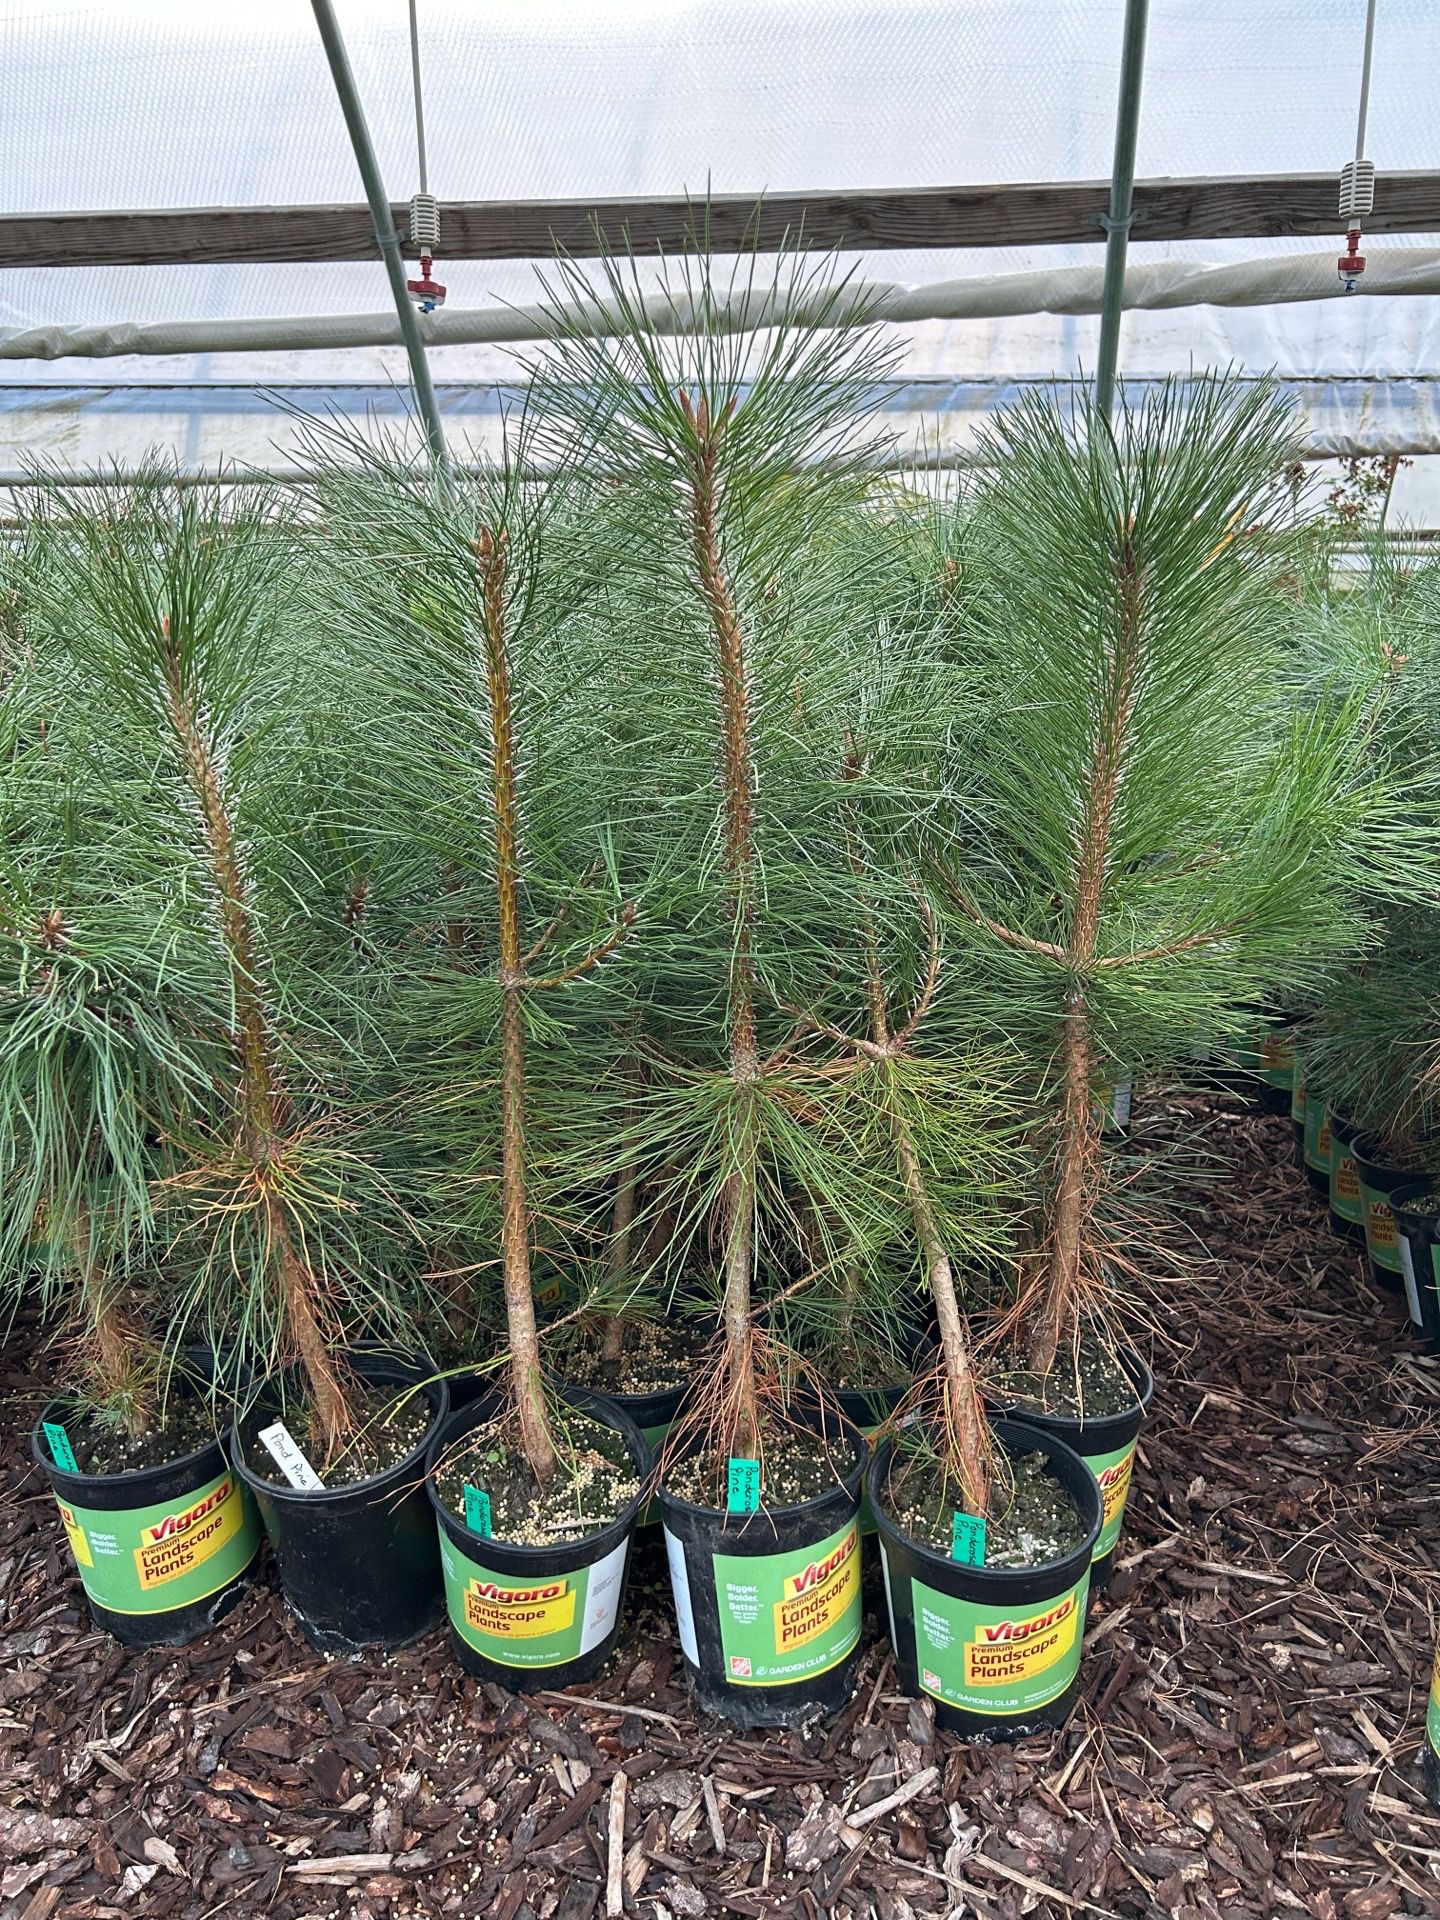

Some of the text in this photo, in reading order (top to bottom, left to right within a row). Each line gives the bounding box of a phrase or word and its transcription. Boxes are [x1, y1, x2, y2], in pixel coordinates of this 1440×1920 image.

[270, 1432, 307, 1486] Pond Pine
[729, 1466, 744, 1494] Pine
[745, 1466, 759, 1512] Ponderos
[149, 1483, 229, 1541] Vigoro
[955, 1519, 970, 1541] Pine
[141, 1537, 180, 1558] Premium
[142, 1516, 223, 1568] Landscape
[145, 1551, 194, 1581] Plants
[792, 1531, 856, 1593] Vigoro
[476, 1583, 560, 1604] Vigoro
[726, 1583, 758, 1594] Bigger.
[727, 1592, 759, 1602] Bolder.
[782, 1569, 851, 1626] Landscape
[468, 1594, 500, 1610] Premium
[468, 1600, 546, 1622] Landscape
[729, 1602, 760, 1612] Better.
[781, 1590, 819, 1613] Premium
[469, 1610, 511, 1631] Plants
[782, 1608, 829, 1643] Plants
[984, 1600, 1071, 1642] Vigoro
[502, 1651, 561, 1661] www.vigoro.com
[971, 1644, 1014, 1653] Premium
[971, 1633, 1058, 1665] Landscape
[768, 1662, 805, 1675] GARDEN
[805, 1653, 827, 1668] CLUB
[970, 1662, 1025, 1678] Plants
[956, 1693, 1019, 1706] GARDEN CLUB
